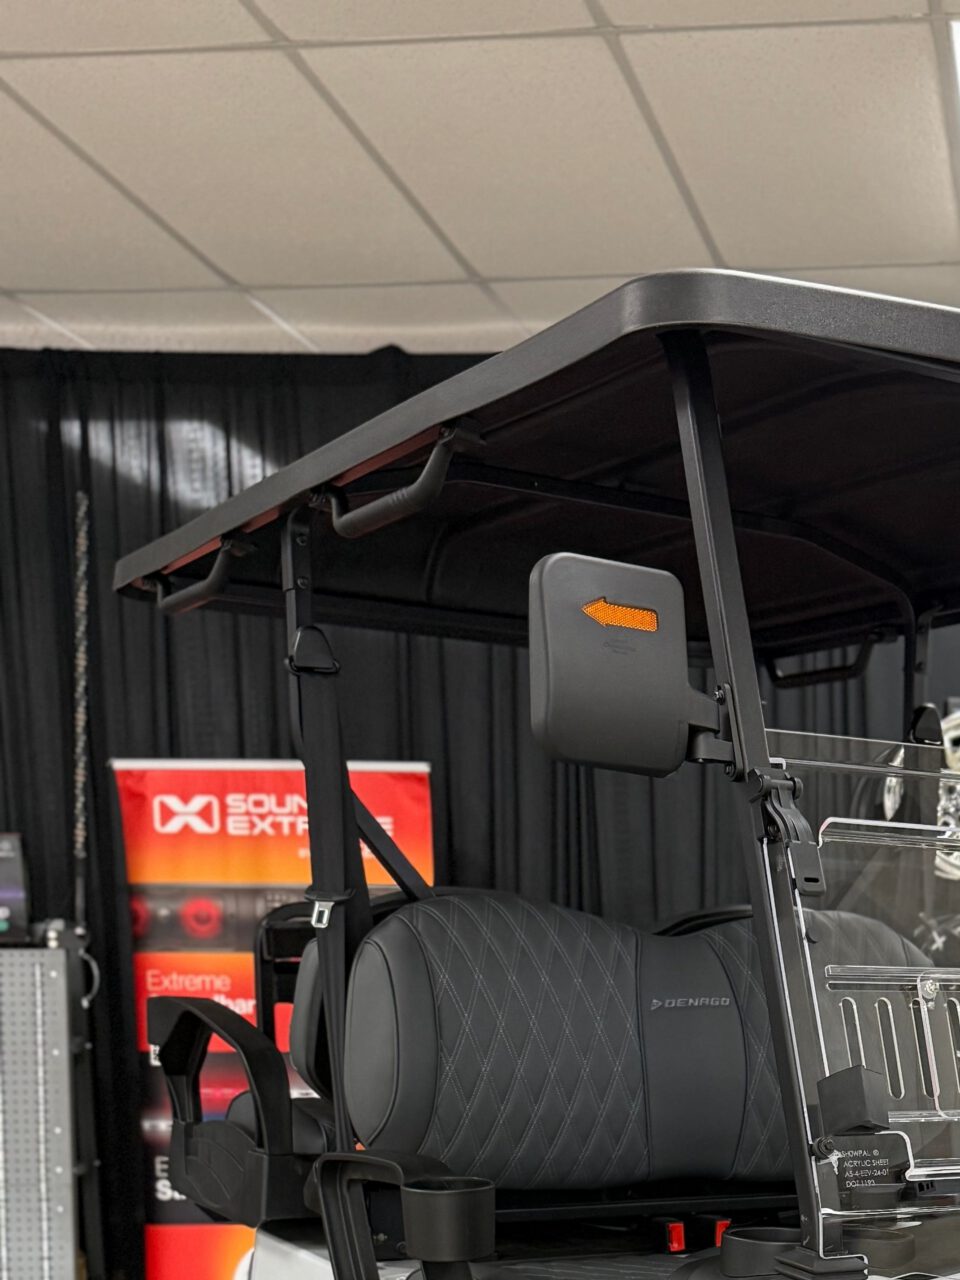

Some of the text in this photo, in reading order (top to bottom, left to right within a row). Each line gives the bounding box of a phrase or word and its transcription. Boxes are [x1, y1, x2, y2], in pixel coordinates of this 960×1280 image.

[225, 793, 308, 814] SOUN
[146, 970, 231, 992] Extreme
[664, 997, 730, 1008] DENAGO
